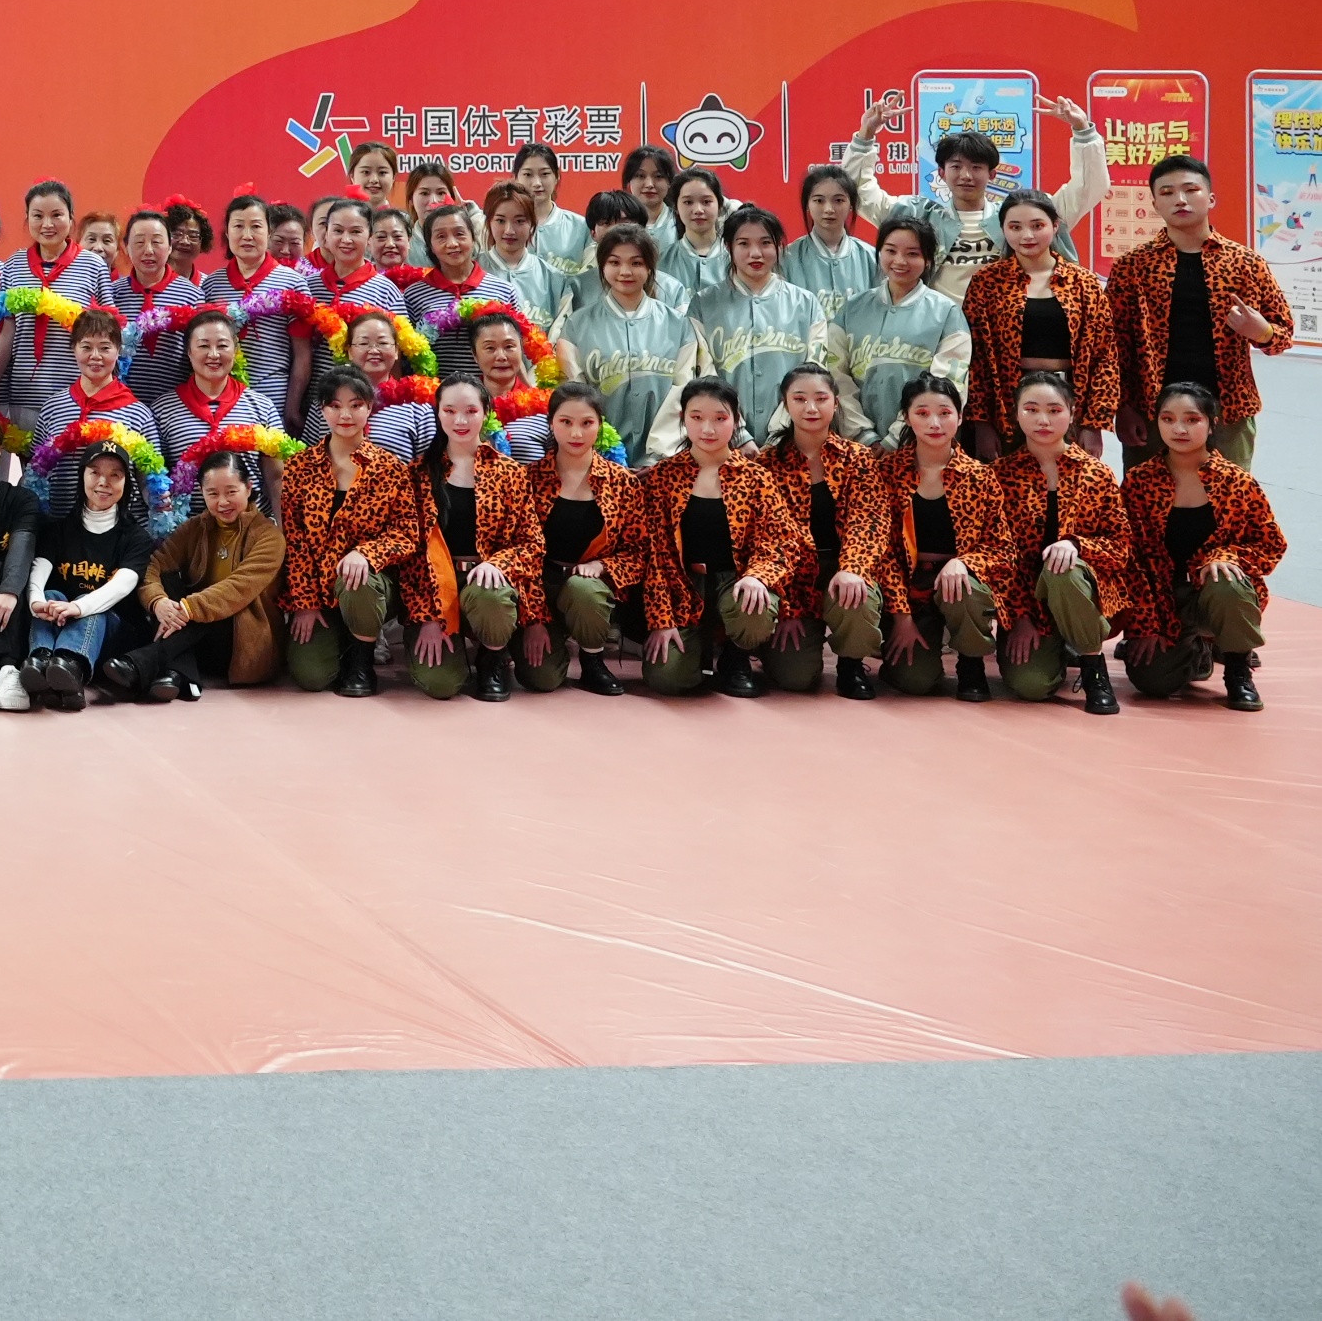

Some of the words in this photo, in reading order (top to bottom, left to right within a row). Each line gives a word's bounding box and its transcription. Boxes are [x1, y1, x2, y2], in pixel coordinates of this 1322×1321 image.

[382, 106, 621, 147] 中国体育彩票
[938, 117, 975, 132] 每一次
[1105, 117, 1189, 143] 让快乐与
[399, 153, 446, 173] HINA
[449, 153, 514, 173] SPORT
[557, 153, 622, 173] TTERY
[709, 325, 806, 363] California
